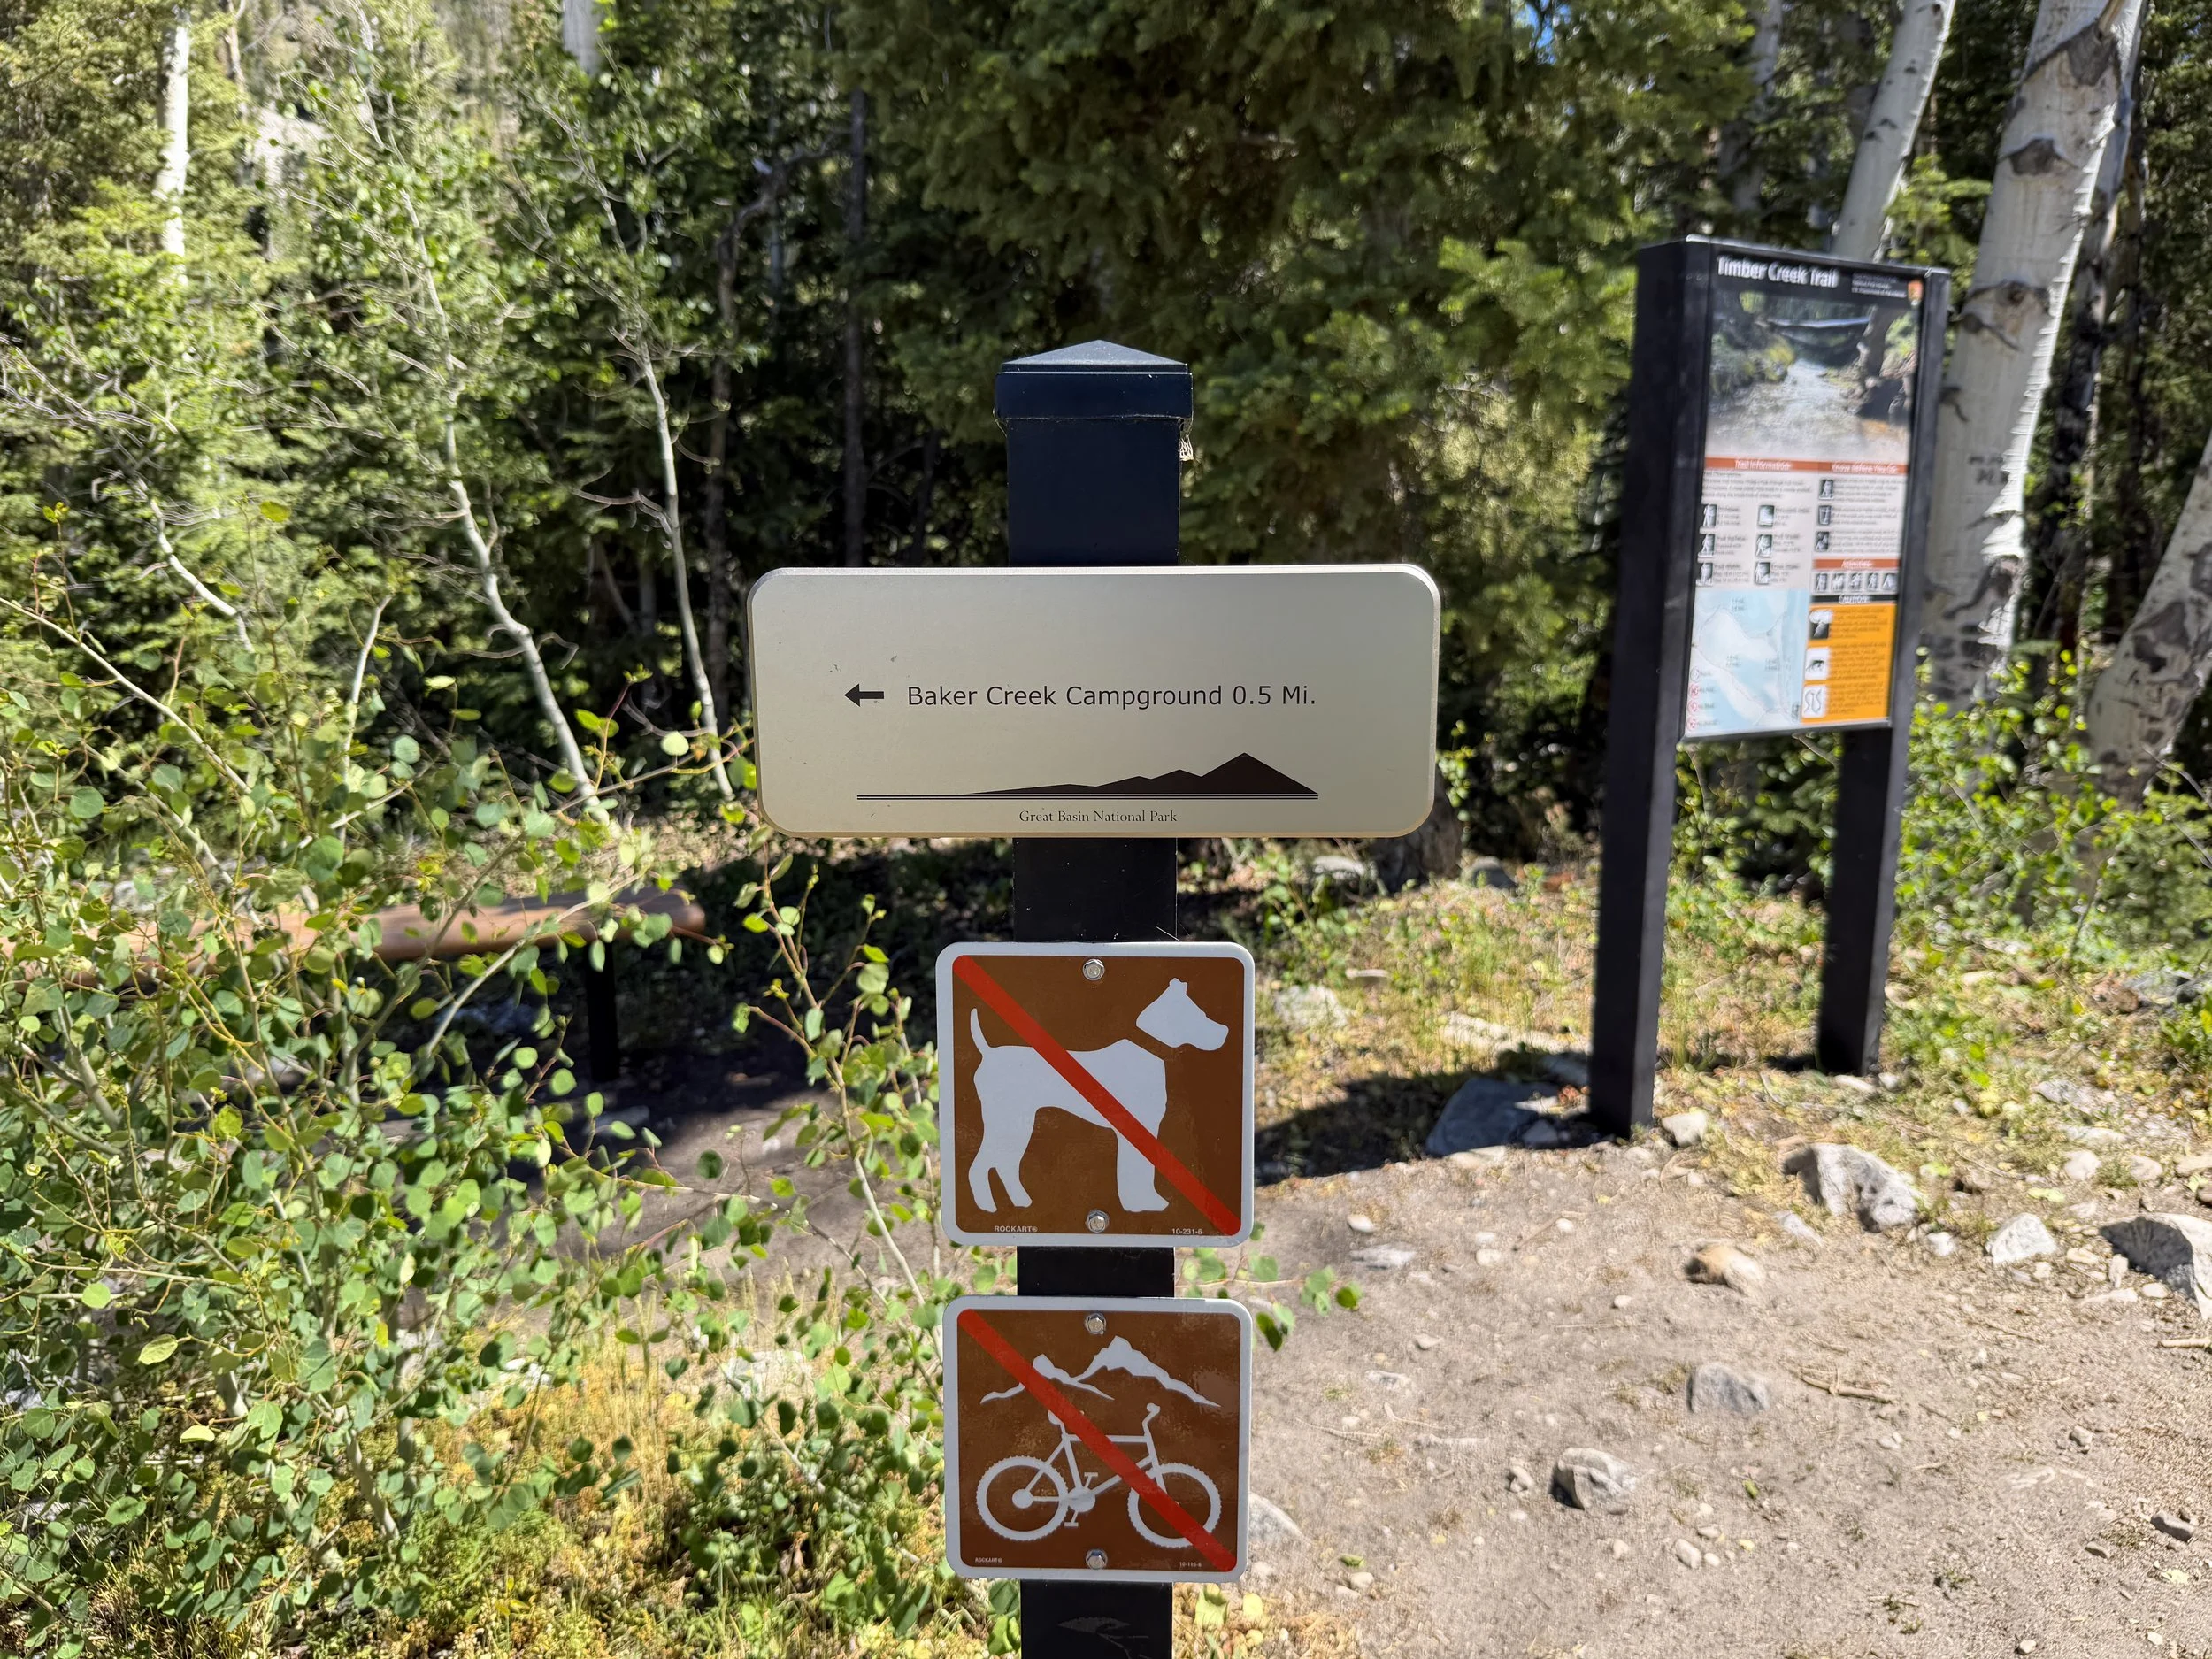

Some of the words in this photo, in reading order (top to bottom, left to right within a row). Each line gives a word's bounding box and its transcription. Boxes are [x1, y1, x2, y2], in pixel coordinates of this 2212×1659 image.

[1717, 255, 1767, 280] Timber
[1768, 262, 1809, 285] Creek
[1809, 267, 1839, 288] Trail
[909, 686, 977, 706] Baker
[987, 685, 1057, 706] Creek
[1067, 685, 1222, 710] Campground
[1233, 685, 1271, 705] 0.5
[1283, 685, 1316, 705] Mi.
[1019, 810, 1054, 822] Great
[1058, 810, 1089, 822] Basin
[1094, 810, 1146, 822] National
[1151, 810, 1178, 822] Park
